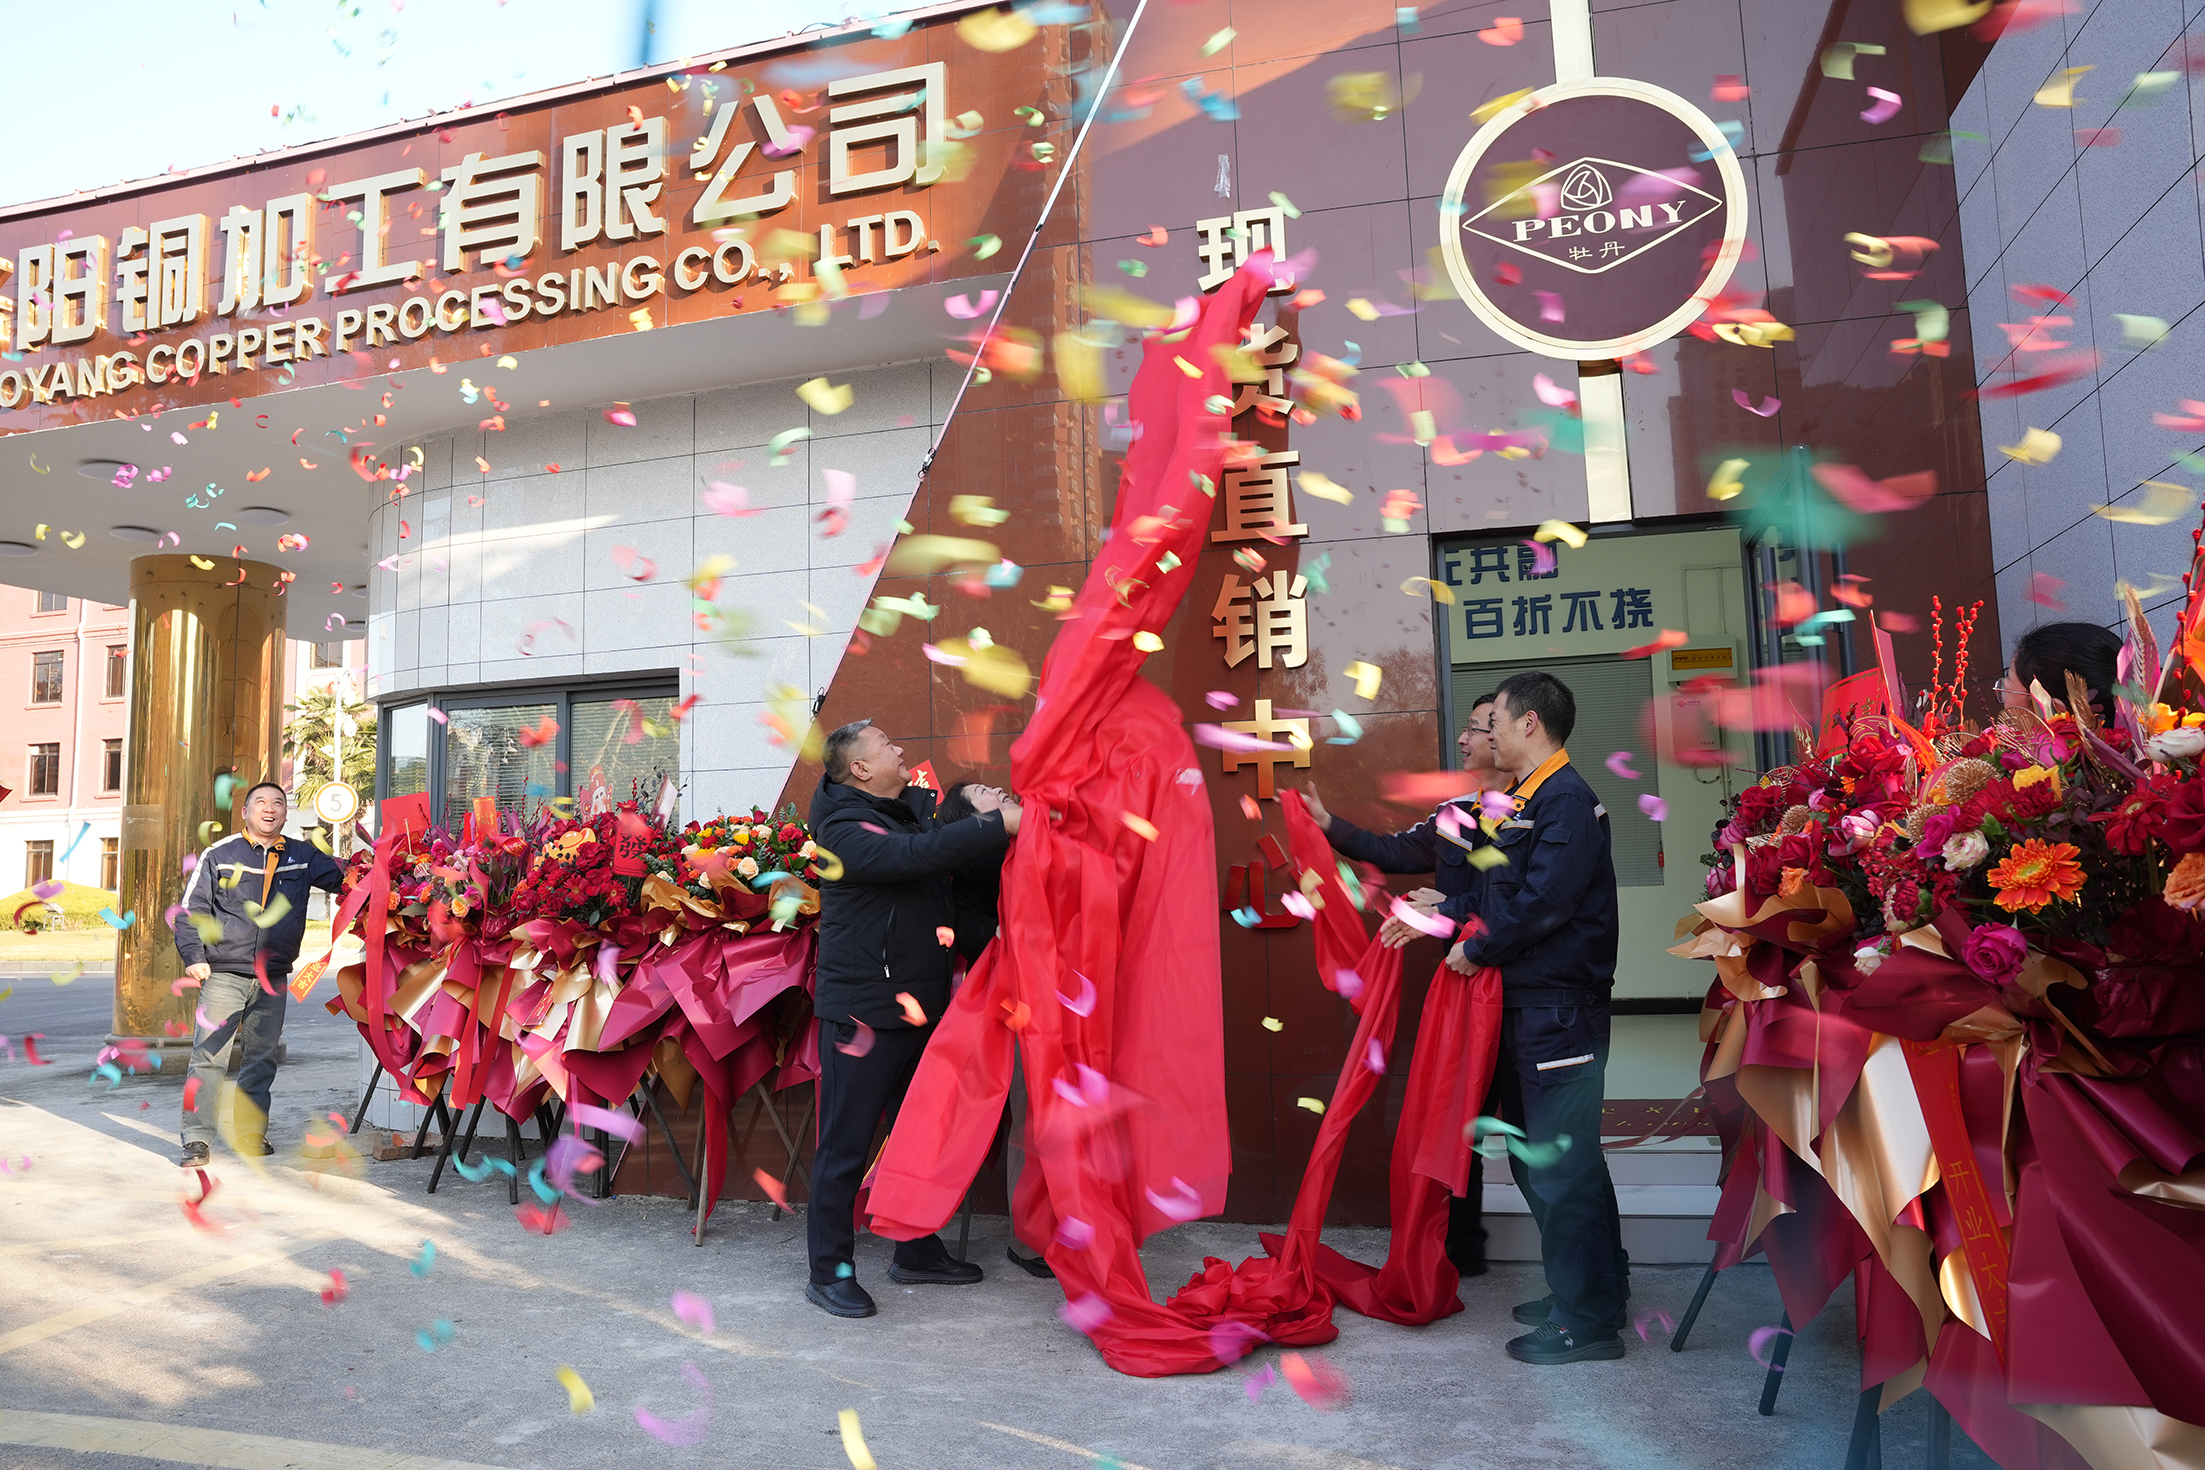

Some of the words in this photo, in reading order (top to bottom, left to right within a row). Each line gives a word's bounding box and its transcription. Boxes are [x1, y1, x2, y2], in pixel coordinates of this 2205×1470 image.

[0, 61, 948, 351] 阳铜加工有限公司
[1511, 201, 1686, 242] PEONY
[1569, 241, 1626, 261] 牡丹
[146, 317, 331, 384] COPPER
[336, 255, 663, 352] PROCESSING
[820, 210, 939, 268] LTD.
[1463, 588, 1654, 640] 百折不挠
[330, 793, 342, 812] 5
